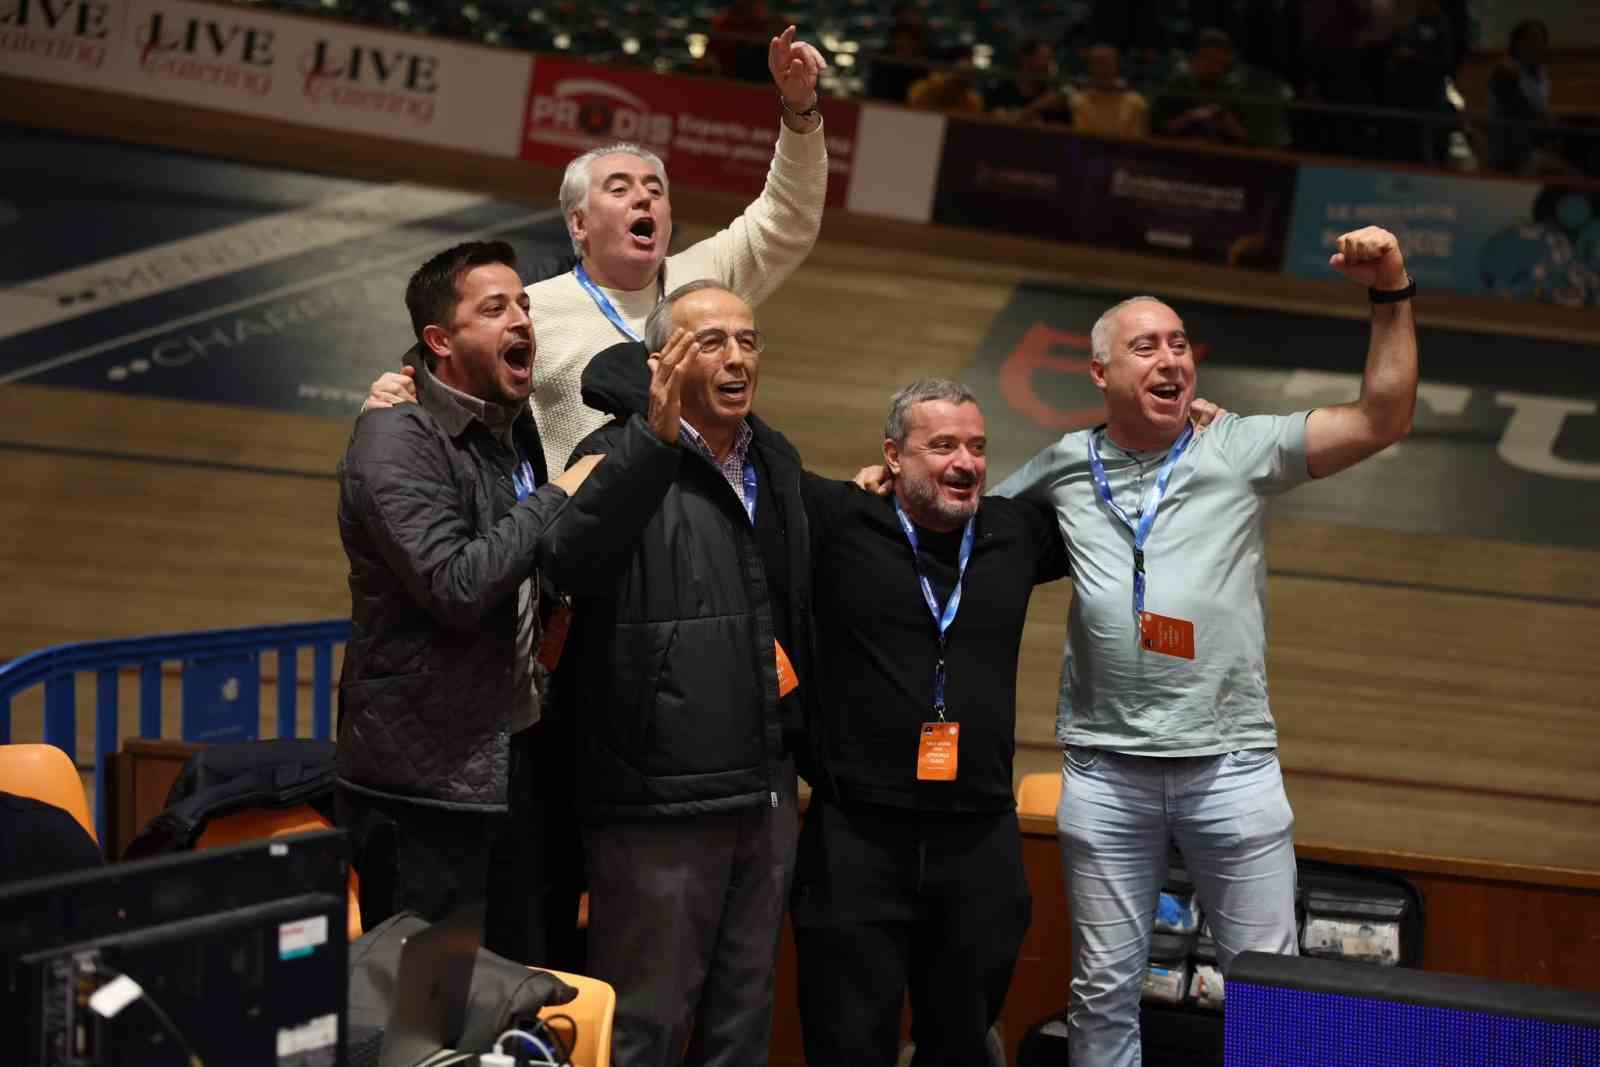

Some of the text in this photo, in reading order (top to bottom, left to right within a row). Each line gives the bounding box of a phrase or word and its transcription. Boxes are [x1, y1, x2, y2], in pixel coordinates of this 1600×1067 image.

[0, 0, 107, 37] IVE
[149, 12, 273, 66] LIVE
[309, 38, 439, 93] LIVE
[533, 93, 673, 146] PRODIS
